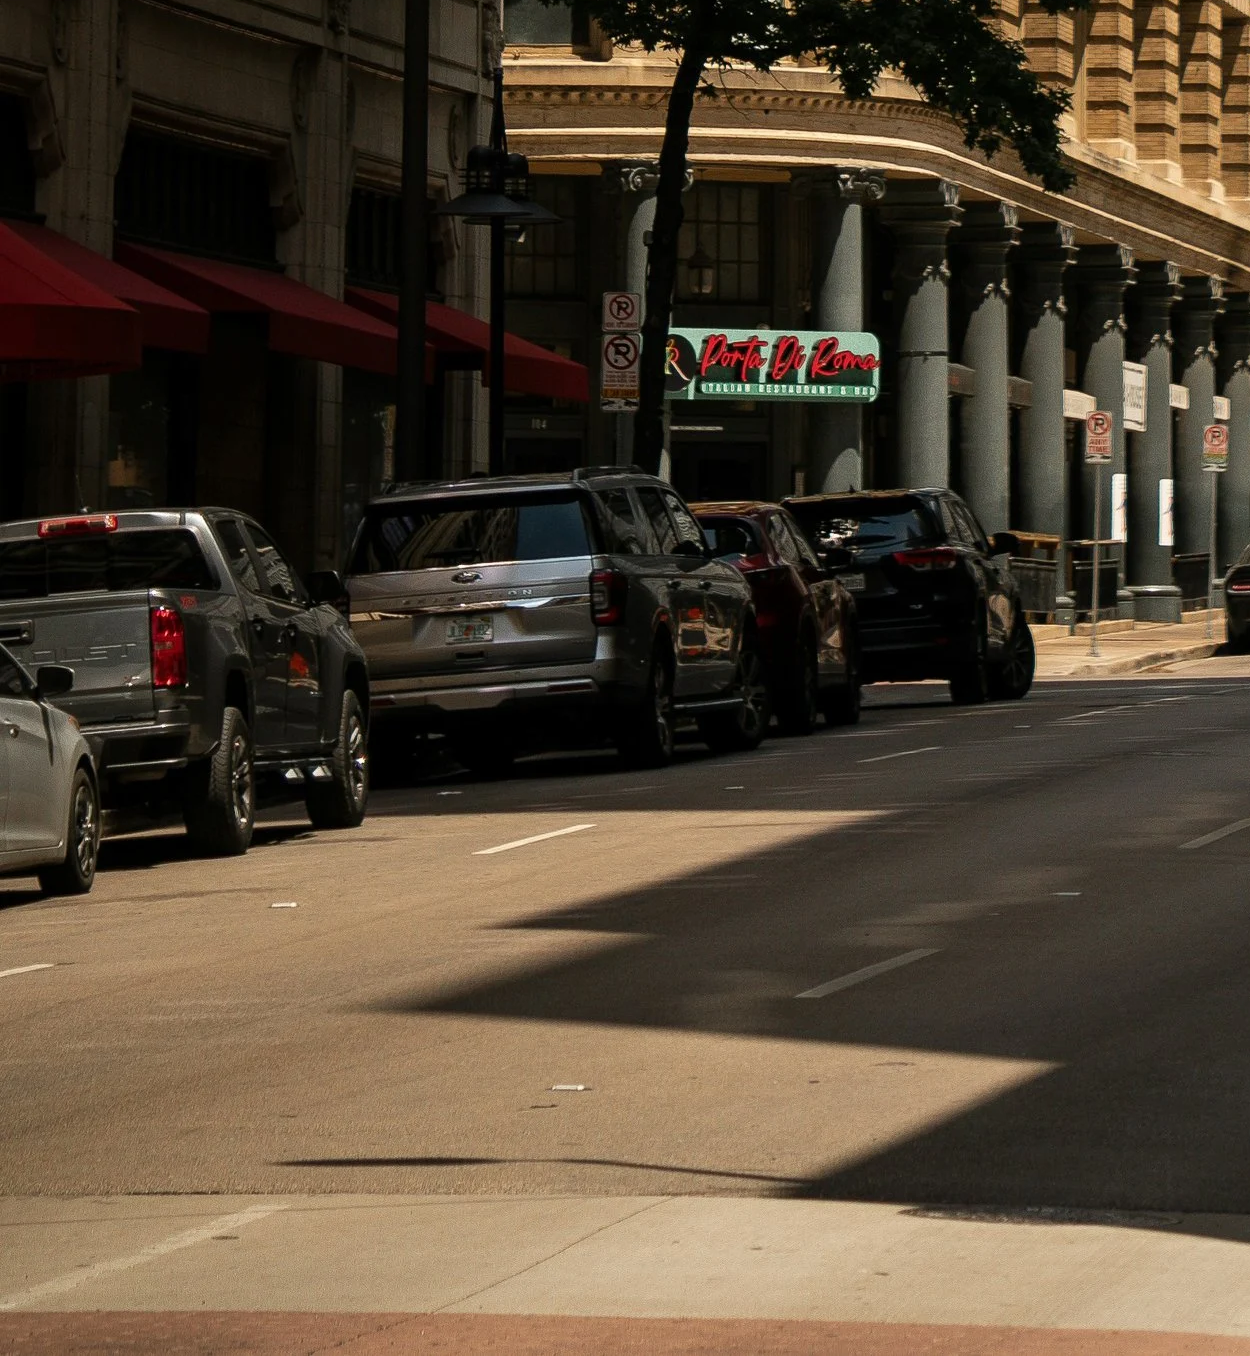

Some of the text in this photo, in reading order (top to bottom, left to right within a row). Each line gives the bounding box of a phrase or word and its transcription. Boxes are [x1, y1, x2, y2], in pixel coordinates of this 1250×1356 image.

[701, 333, 881, 382] Porta Di Roma
